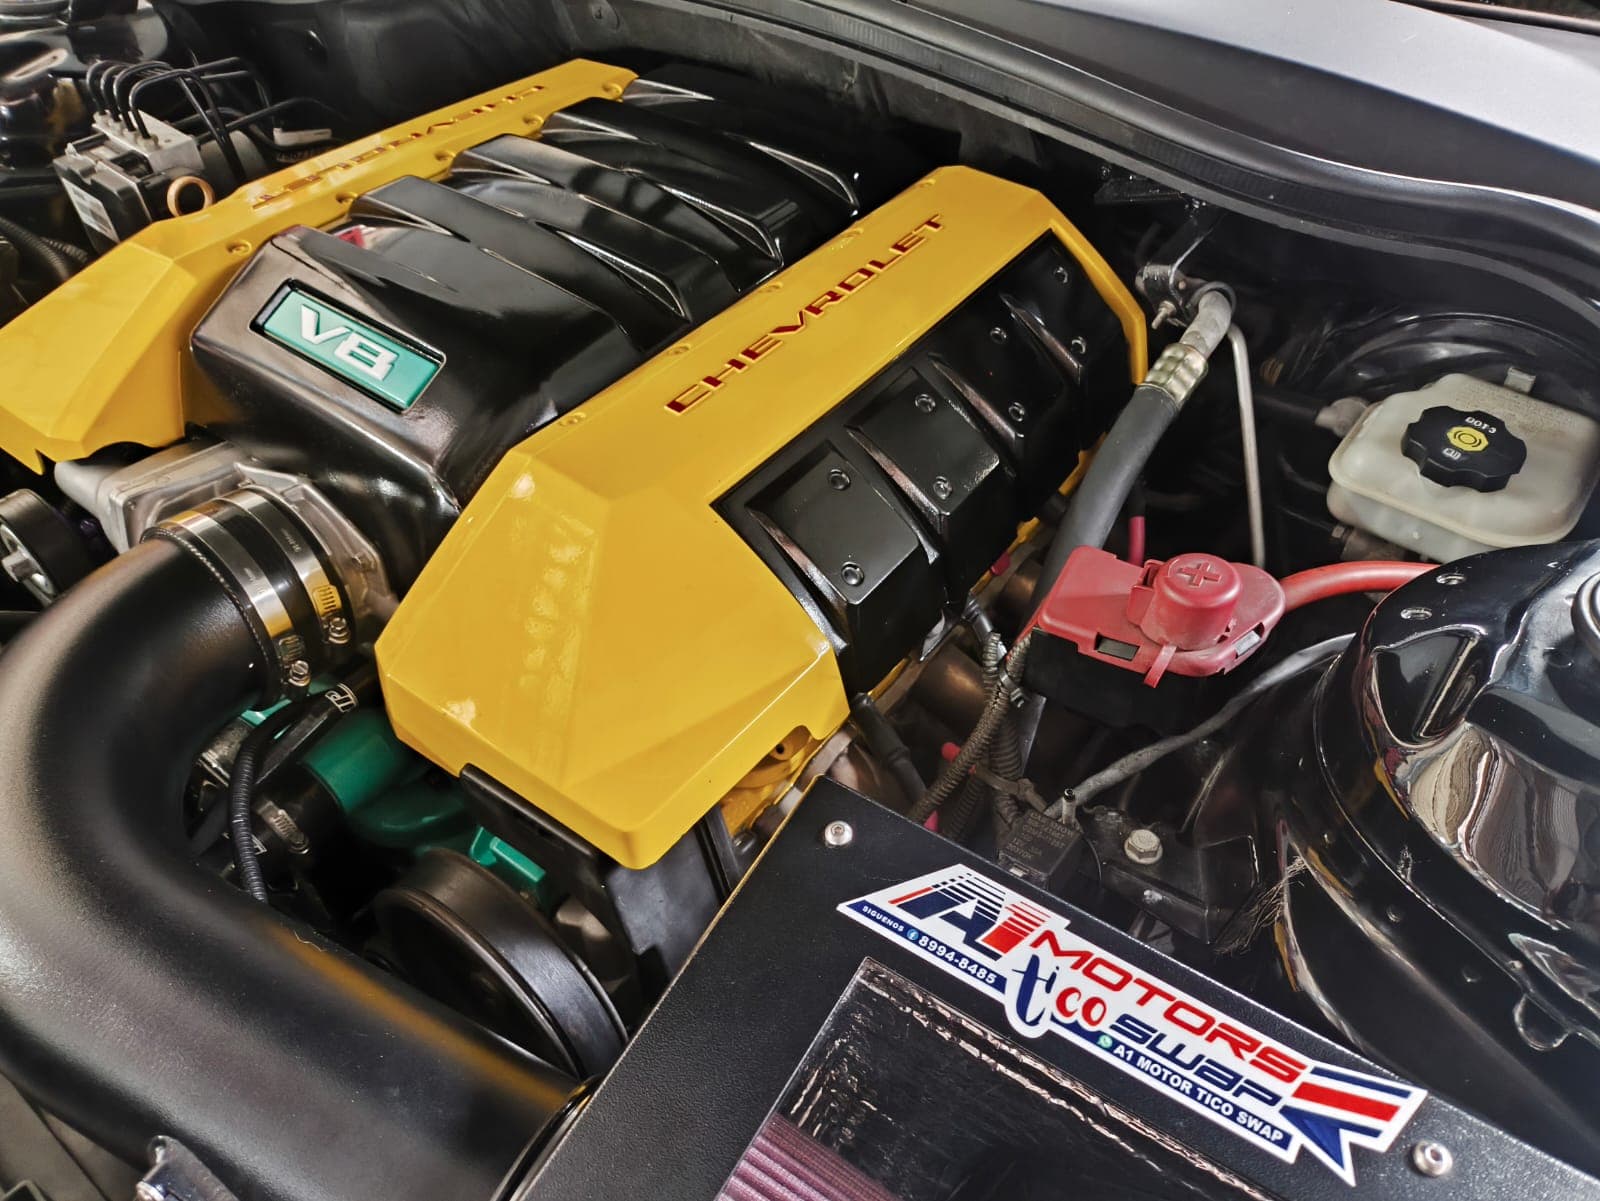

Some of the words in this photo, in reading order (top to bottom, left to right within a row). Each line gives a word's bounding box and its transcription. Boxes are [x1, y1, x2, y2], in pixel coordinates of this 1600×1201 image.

[301, 304, 397, 381] V8
[663, 213, 947, 414] CHEVROLET
[862, 905, 904, 932] SIGUENOS
[918, 935, 997, 985] 8994-8485
[1029, 929, 1308, 1084] MOTORS
[1113, 1044, 1134, 1062] A1
[1136, 1056, 1192, 1098] MOTOR
[1196, 1088, 1233, 1117] TICO
[1236, 1109, 1284, 1143] SWAP
